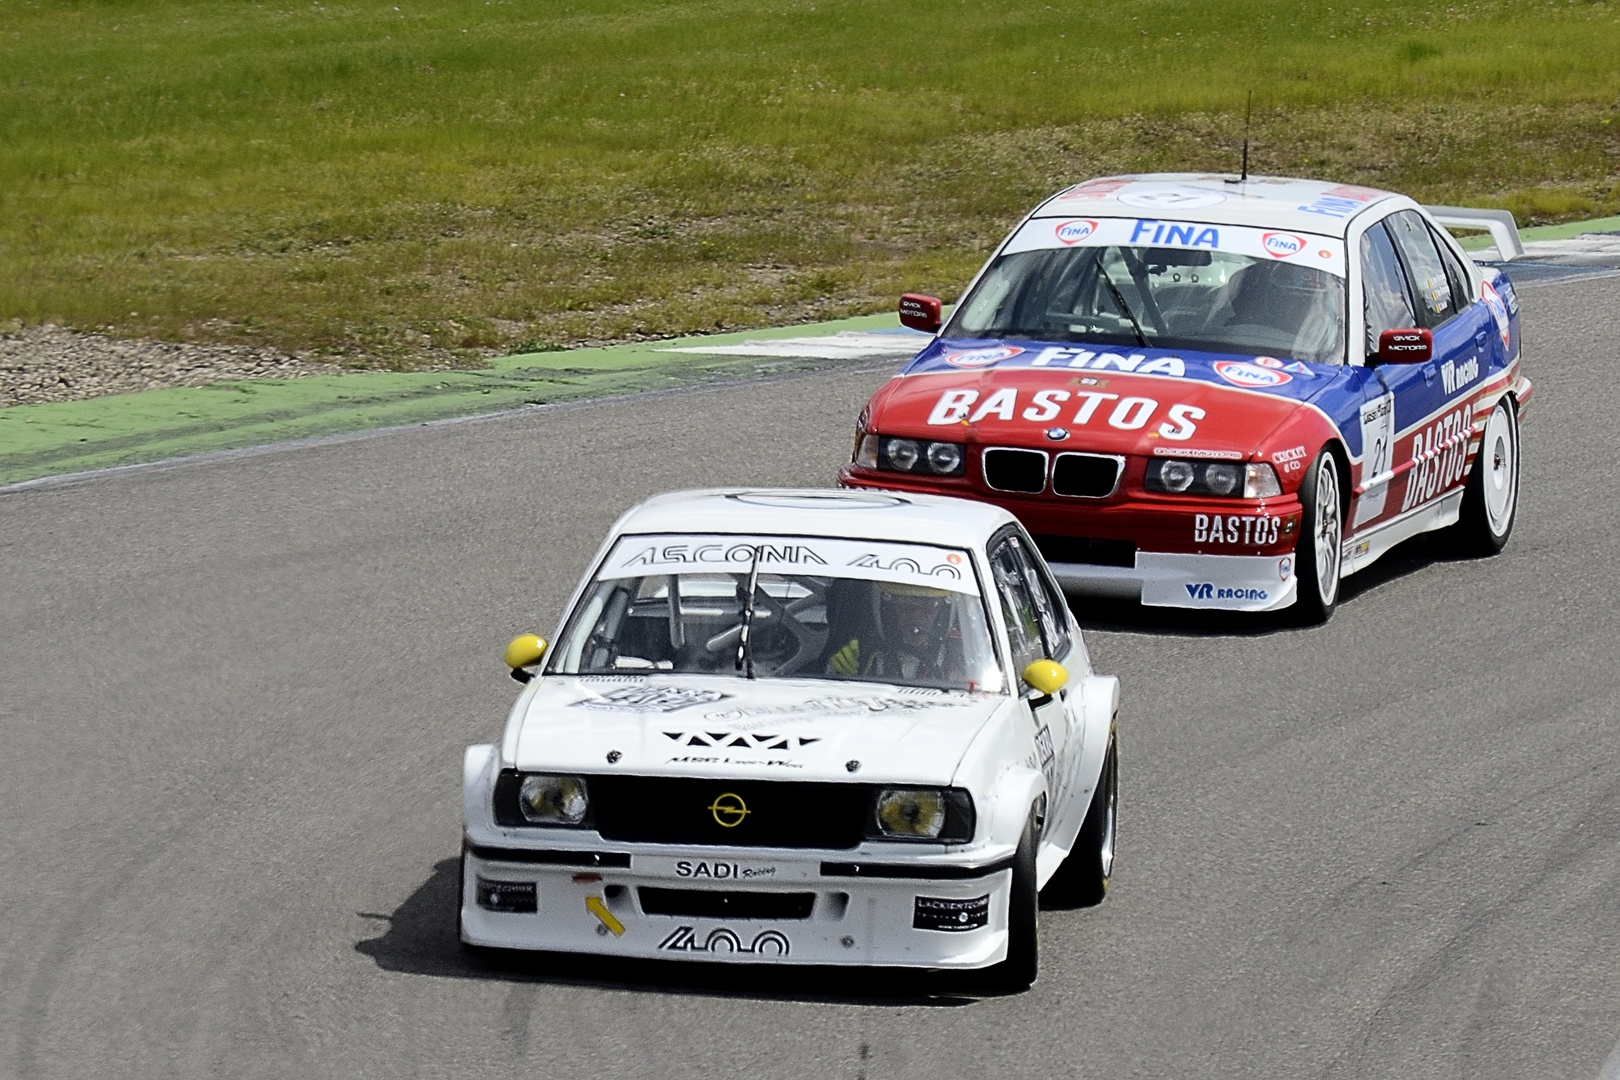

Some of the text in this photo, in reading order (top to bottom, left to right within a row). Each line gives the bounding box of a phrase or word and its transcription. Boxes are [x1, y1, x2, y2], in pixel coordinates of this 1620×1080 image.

[1060, 223, 1090, 237] FINA
[1128, 219, 1219, 248] FINA
[1267, 238, 1297, 251] FINA
[957, 350, 1005, 364] FINA
[1032, 347, 1186, 377] FINA
[1225, 367, 1276, 383] FINA
[927, 388, 1207, 441] BASTOS
[1401, 404, 1473, 513] BASTOS
[1195, 514, 1280, 544] BASTOS
[621, 544, 962, 580] ASCONA 400
[1185, 583, 1268, 600] VR RACING
[676, 861, 776, 879] SADI Racing
[658, 926, 790, 955] 400
